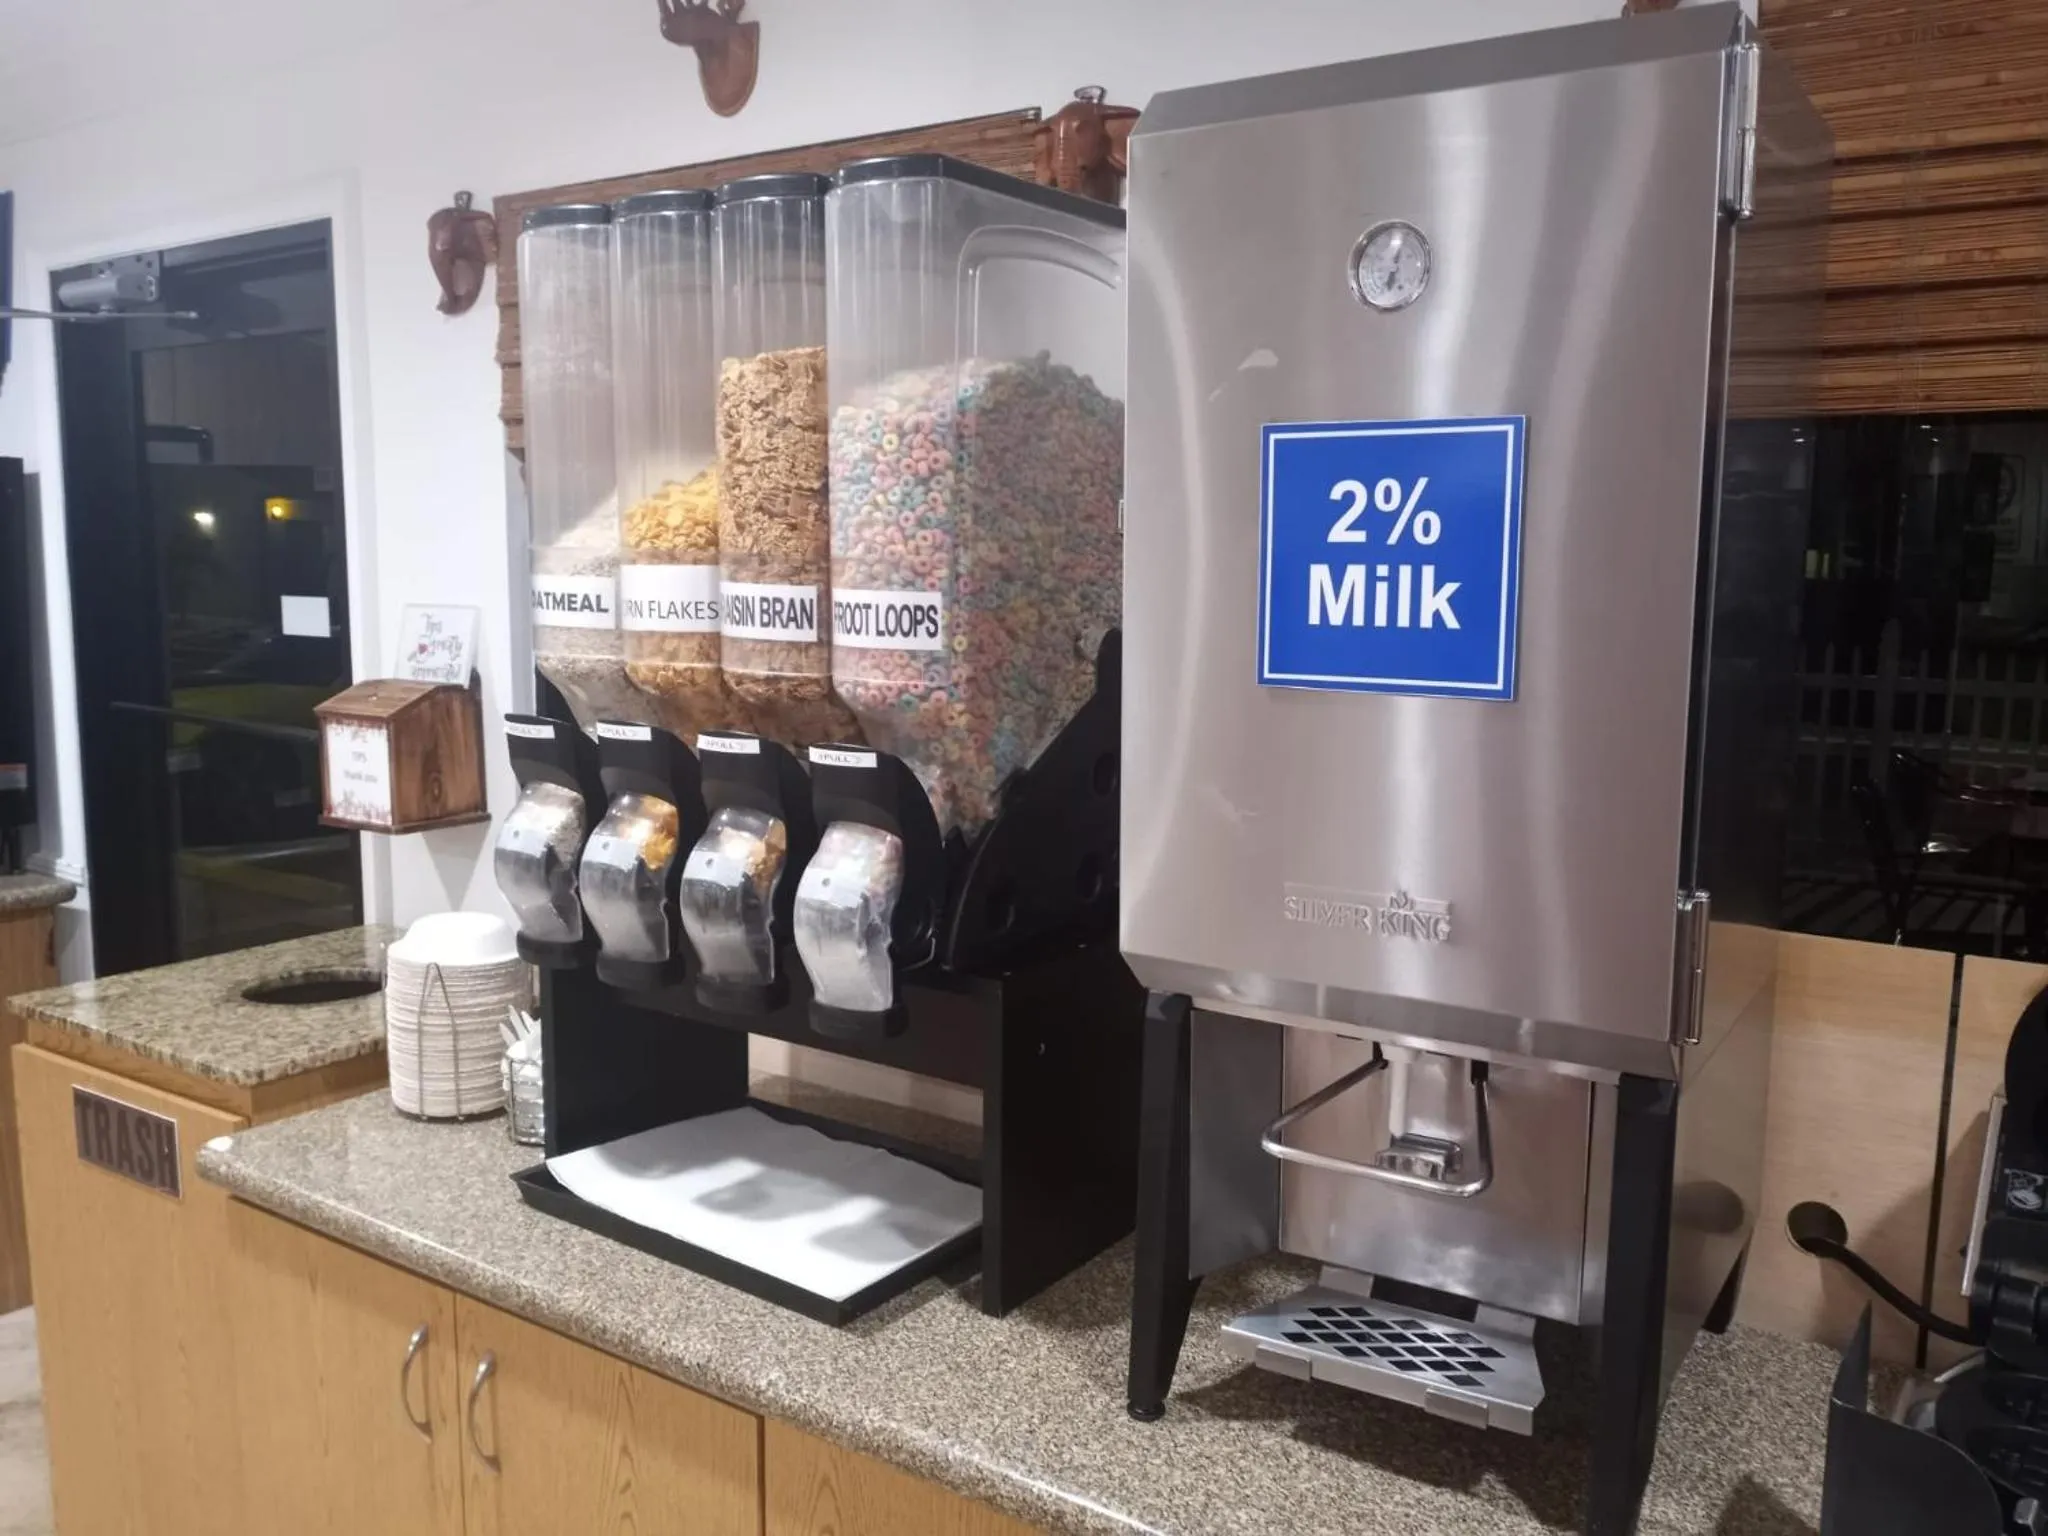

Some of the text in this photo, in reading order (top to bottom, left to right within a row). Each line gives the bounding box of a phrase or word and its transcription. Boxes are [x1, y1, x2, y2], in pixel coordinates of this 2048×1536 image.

[1327, 476, 1442, 546] 2%
[648, 600, 719, 620] FLAKES
[722, 594, 814, 630] AISIN BRAN
[1308, 563, 1463, 629] Milk
[875, 603, 939, 638] LOOPS
[1379, 910, 1452, 942] KING
[74, 1092, 179, 1191] TRASH
